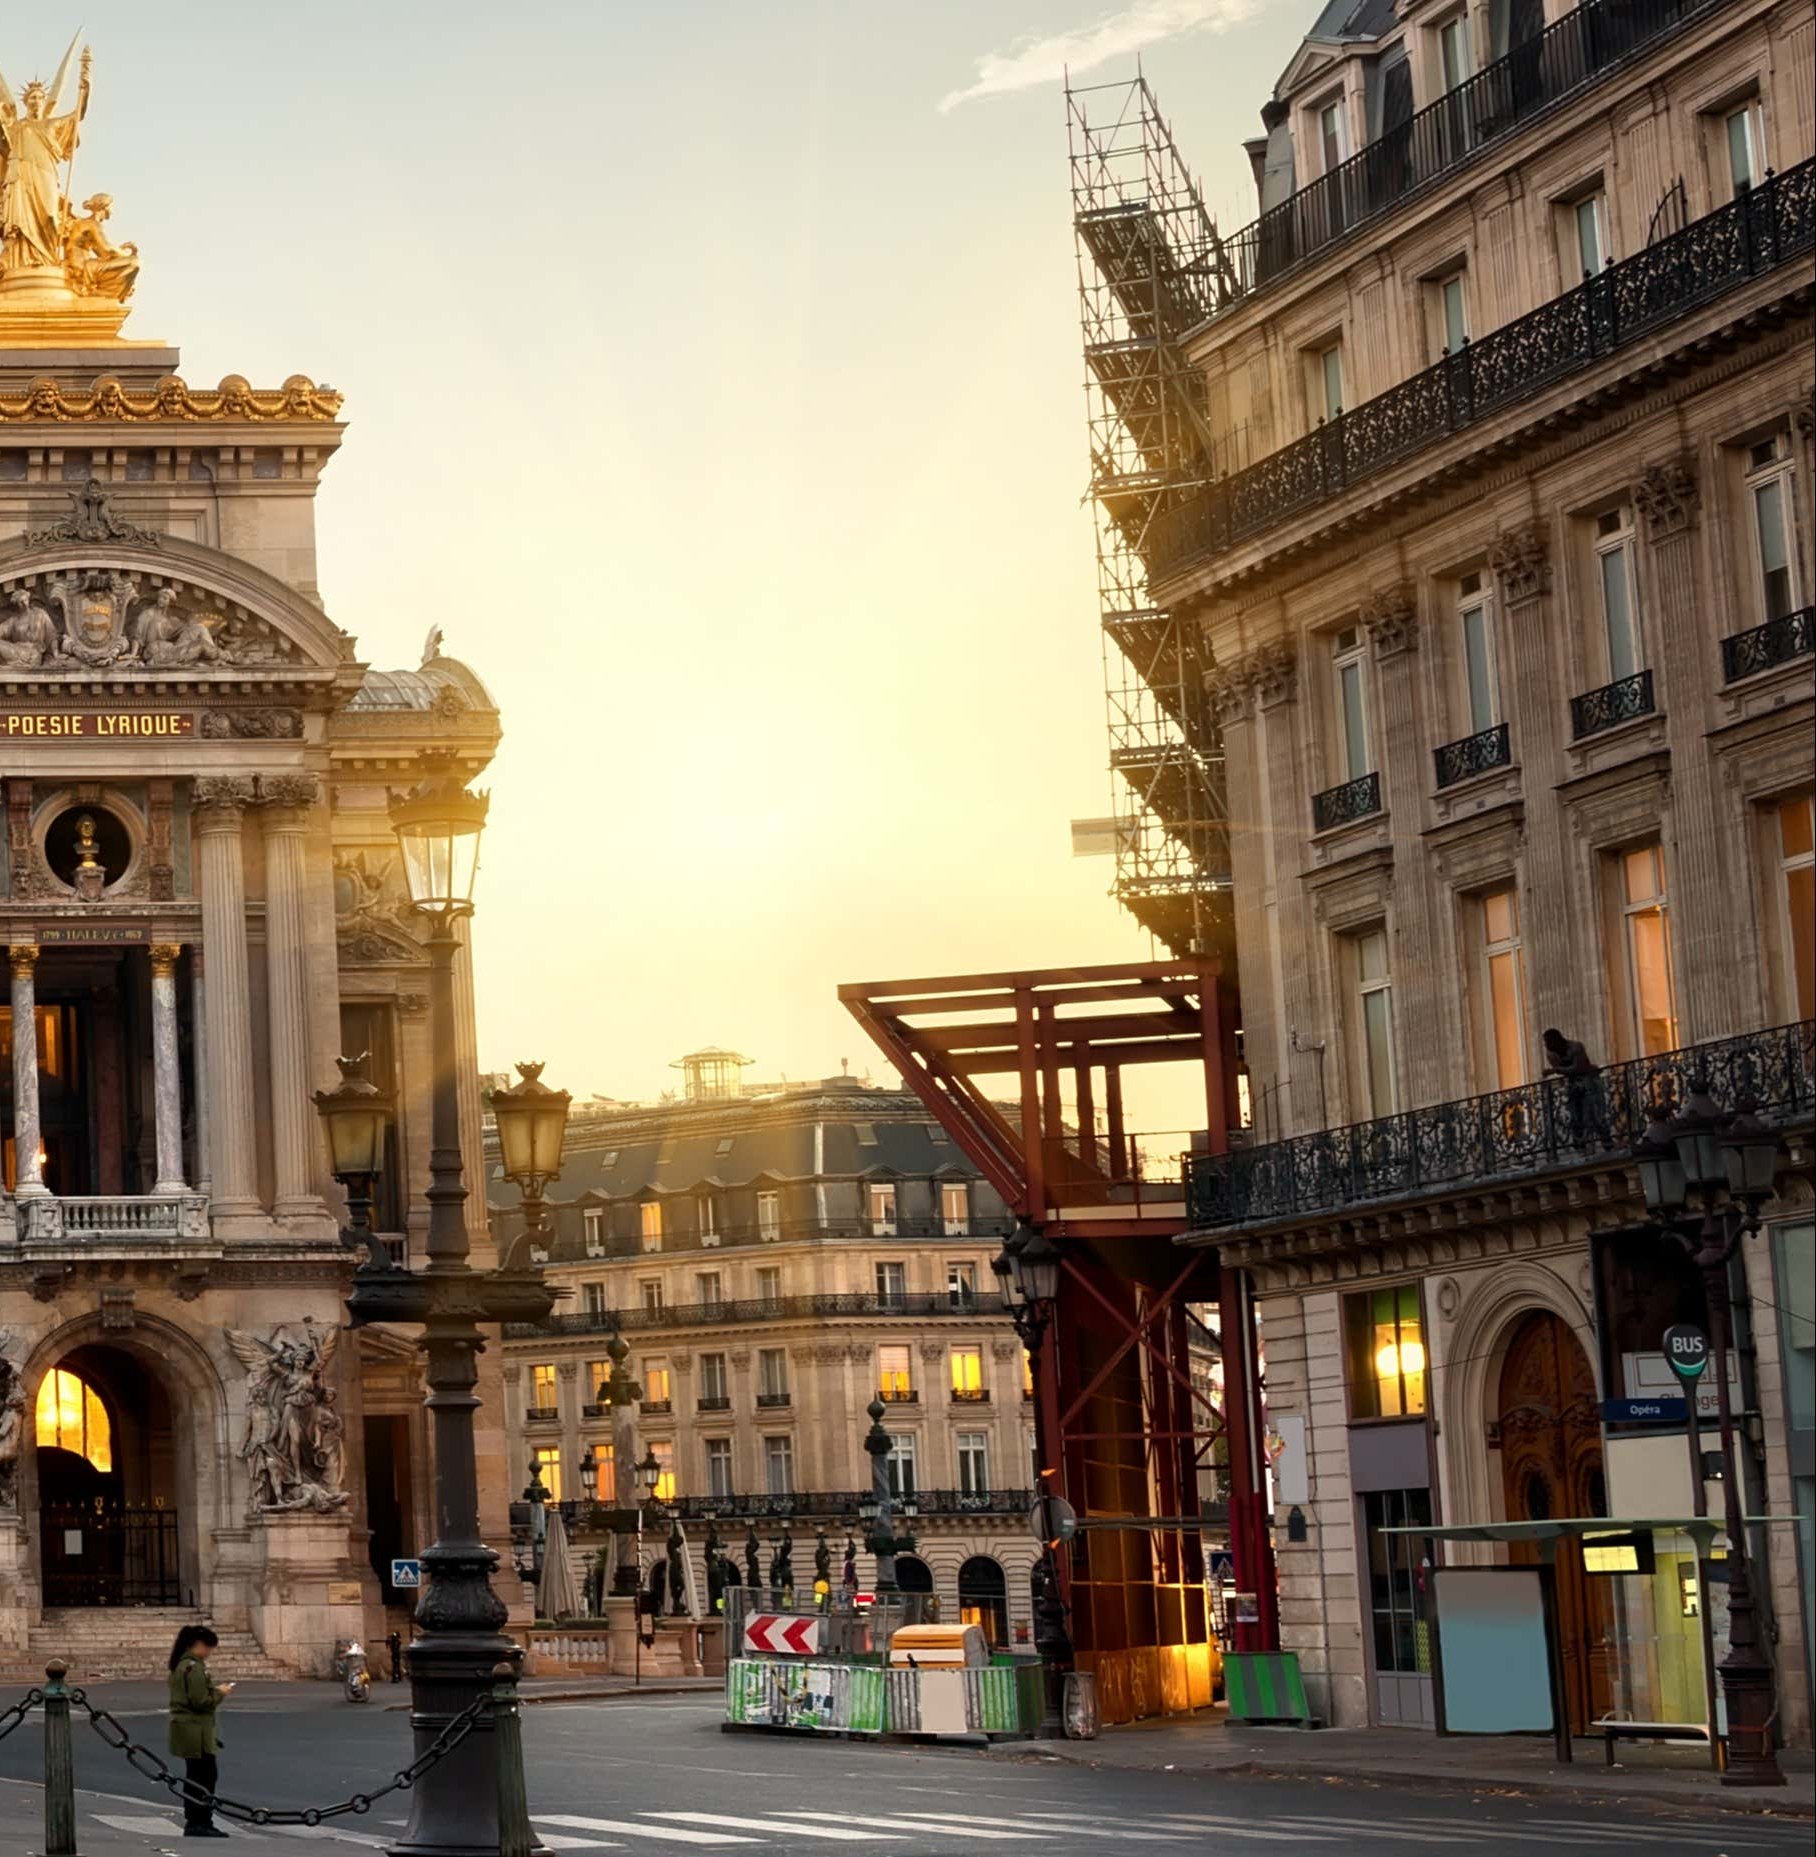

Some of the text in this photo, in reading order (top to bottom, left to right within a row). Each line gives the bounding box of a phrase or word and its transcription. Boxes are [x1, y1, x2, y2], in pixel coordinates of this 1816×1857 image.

[8, 714, 182, 736] POESIE LYRIQUE
[1672, 1336, 1704, 1353] BUS
[1629, 1404, 1661, 1417] Opéra
